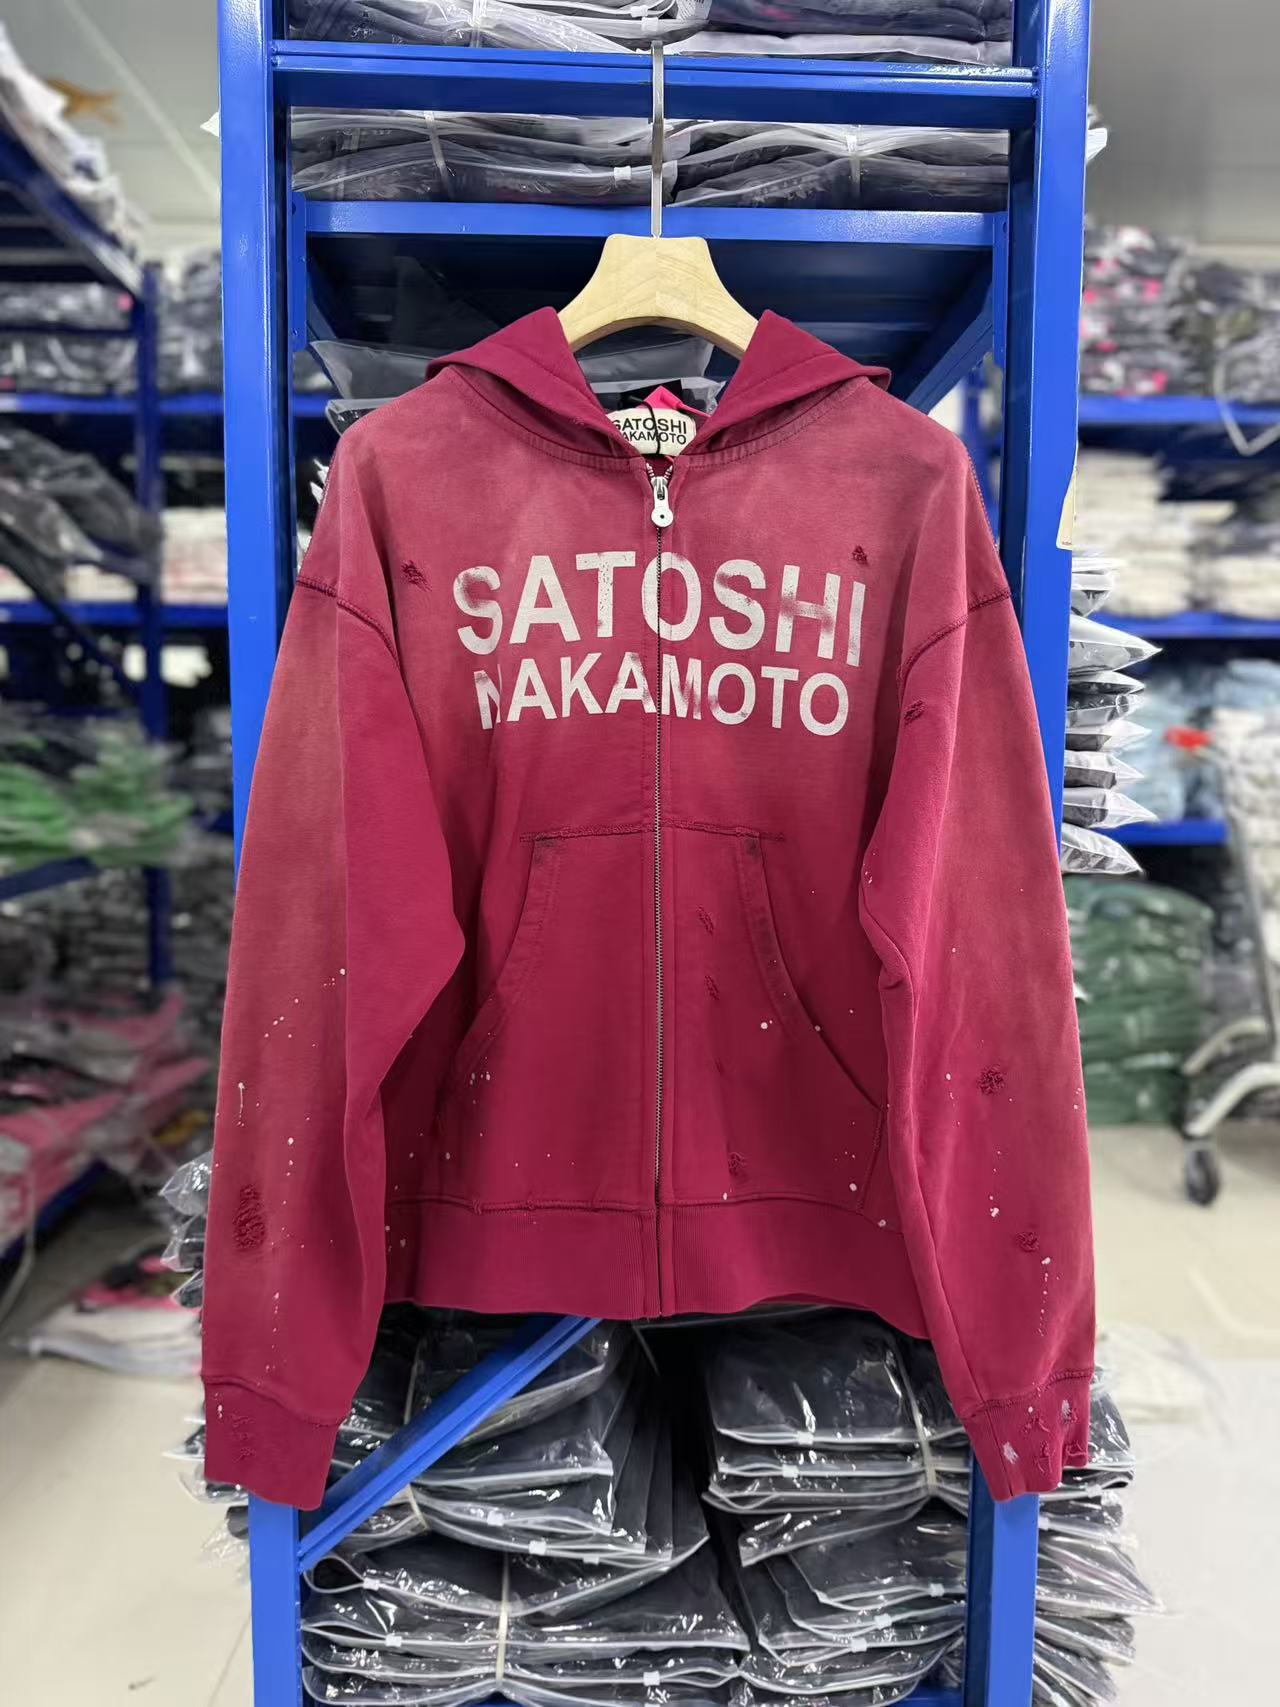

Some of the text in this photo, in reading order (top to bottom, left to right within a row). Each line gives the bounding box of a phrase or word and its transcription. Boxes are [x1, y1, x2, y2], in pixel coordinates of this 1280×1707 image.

[622, 431, 687, 445] AKAMOTO
[453, 551, 866, 667] SATOSHI
[473, 651, 849, 736] NAKAMOTO
